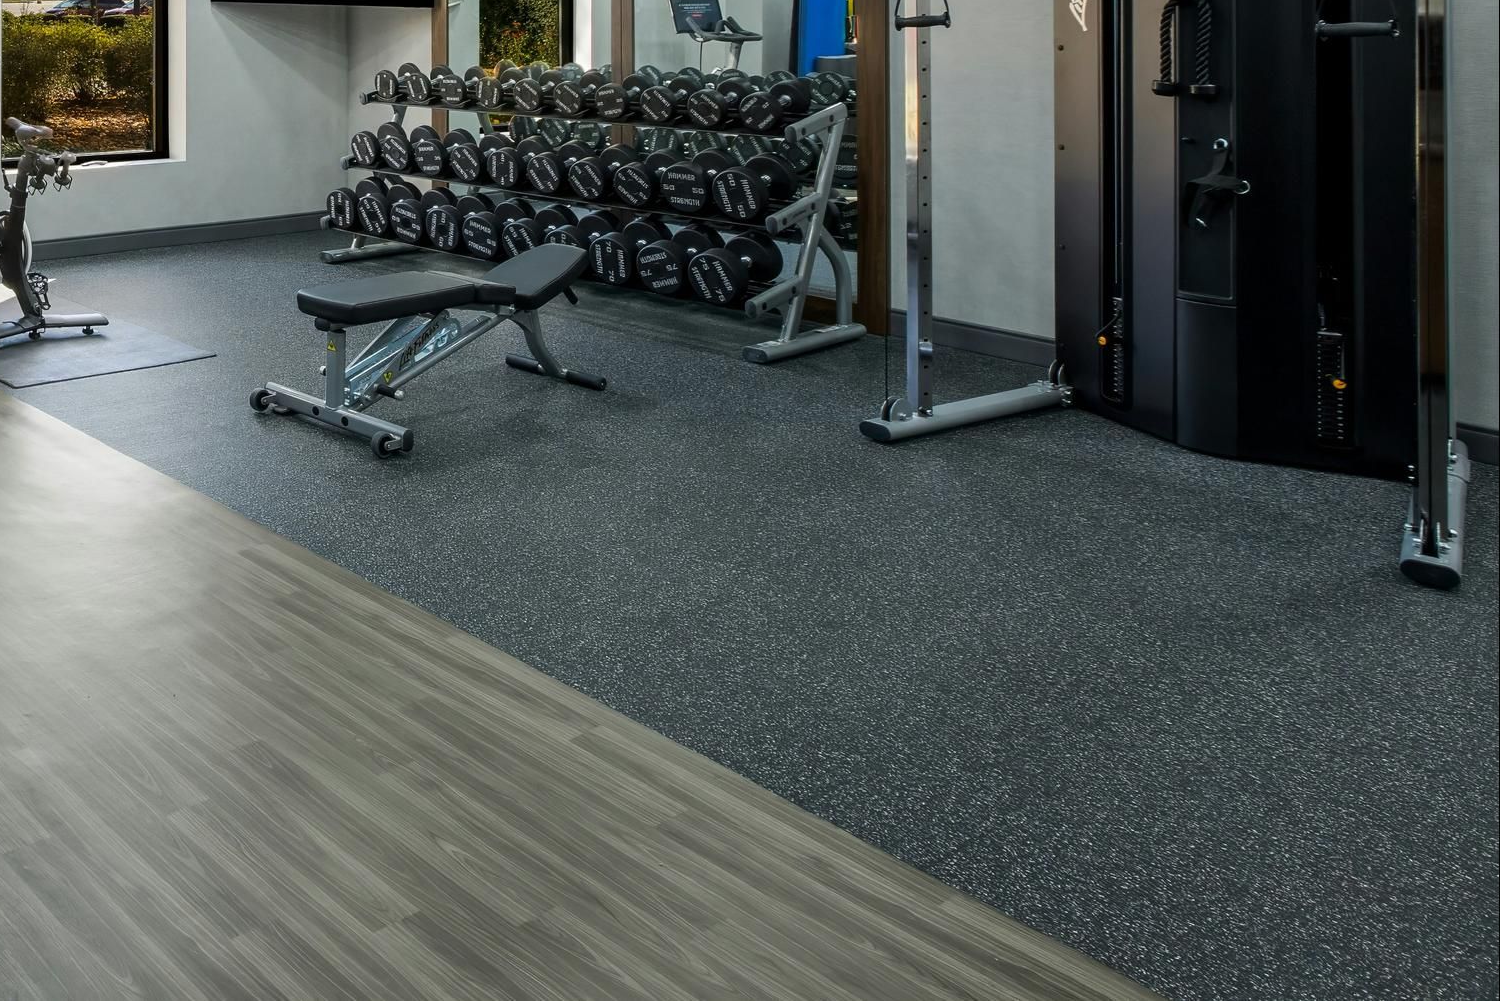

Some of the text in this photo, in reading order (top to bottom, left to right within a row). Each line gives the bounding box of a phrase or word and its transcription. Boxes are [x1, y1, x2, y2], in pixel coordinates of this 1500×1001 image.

[667, 171, 695, 181] HAMMER
[670, 196, 700, 207] STRENGTH
[716, 180, 733, 213] STRENGTH
[740, 179, 757, 210] HAMMER
[595, 243, 603, 274] STRENGTH
[616, 249, 625, 278] HAMMER
[639, 251, 667, 264] STRENGTH
[700, 257, 709, 271] 75
[651, 276, 678, 289] HAMMER
[691, 266, 712, 299] STRENGTH
[712, 260, 733, 292] HAMMER
[715, 289, 725, 302] 75
